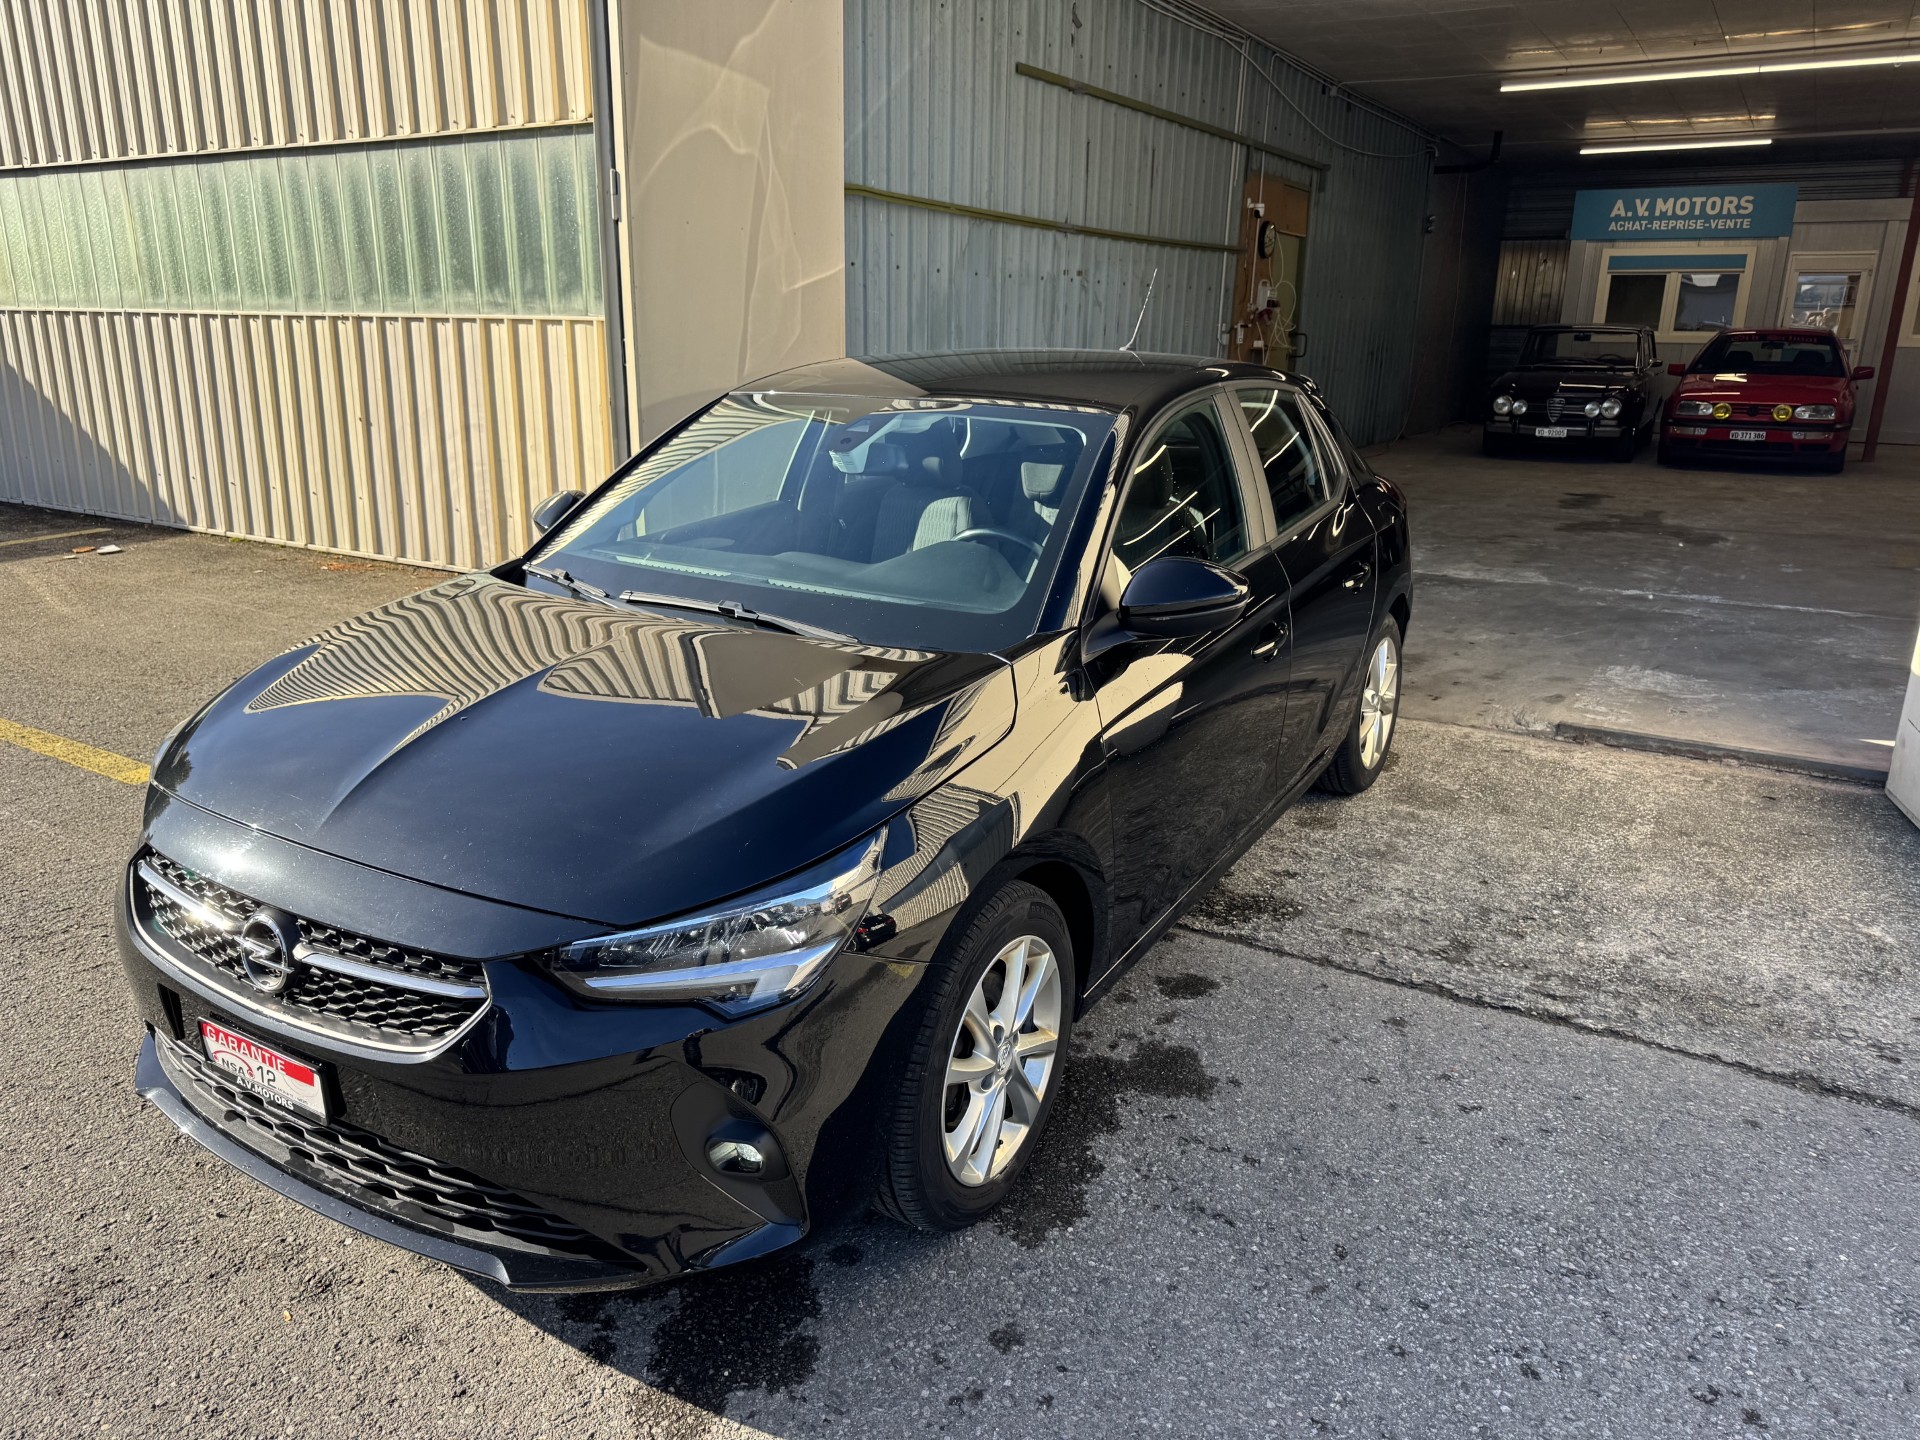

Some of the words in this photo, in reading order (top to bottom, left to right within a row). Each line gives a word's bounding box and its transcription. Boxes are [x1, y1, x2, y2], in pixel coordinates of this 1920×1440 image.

[1655, 196, 1754, 215] MOTORS
[1609, 219, 1751, 231] ACHAT-REPRISE-VENTE
[207, 1026, 286, 1073] GARANTIE
[221, 1057, 246, 1077] NSA
[256, 1065, 277, 1089] 12
